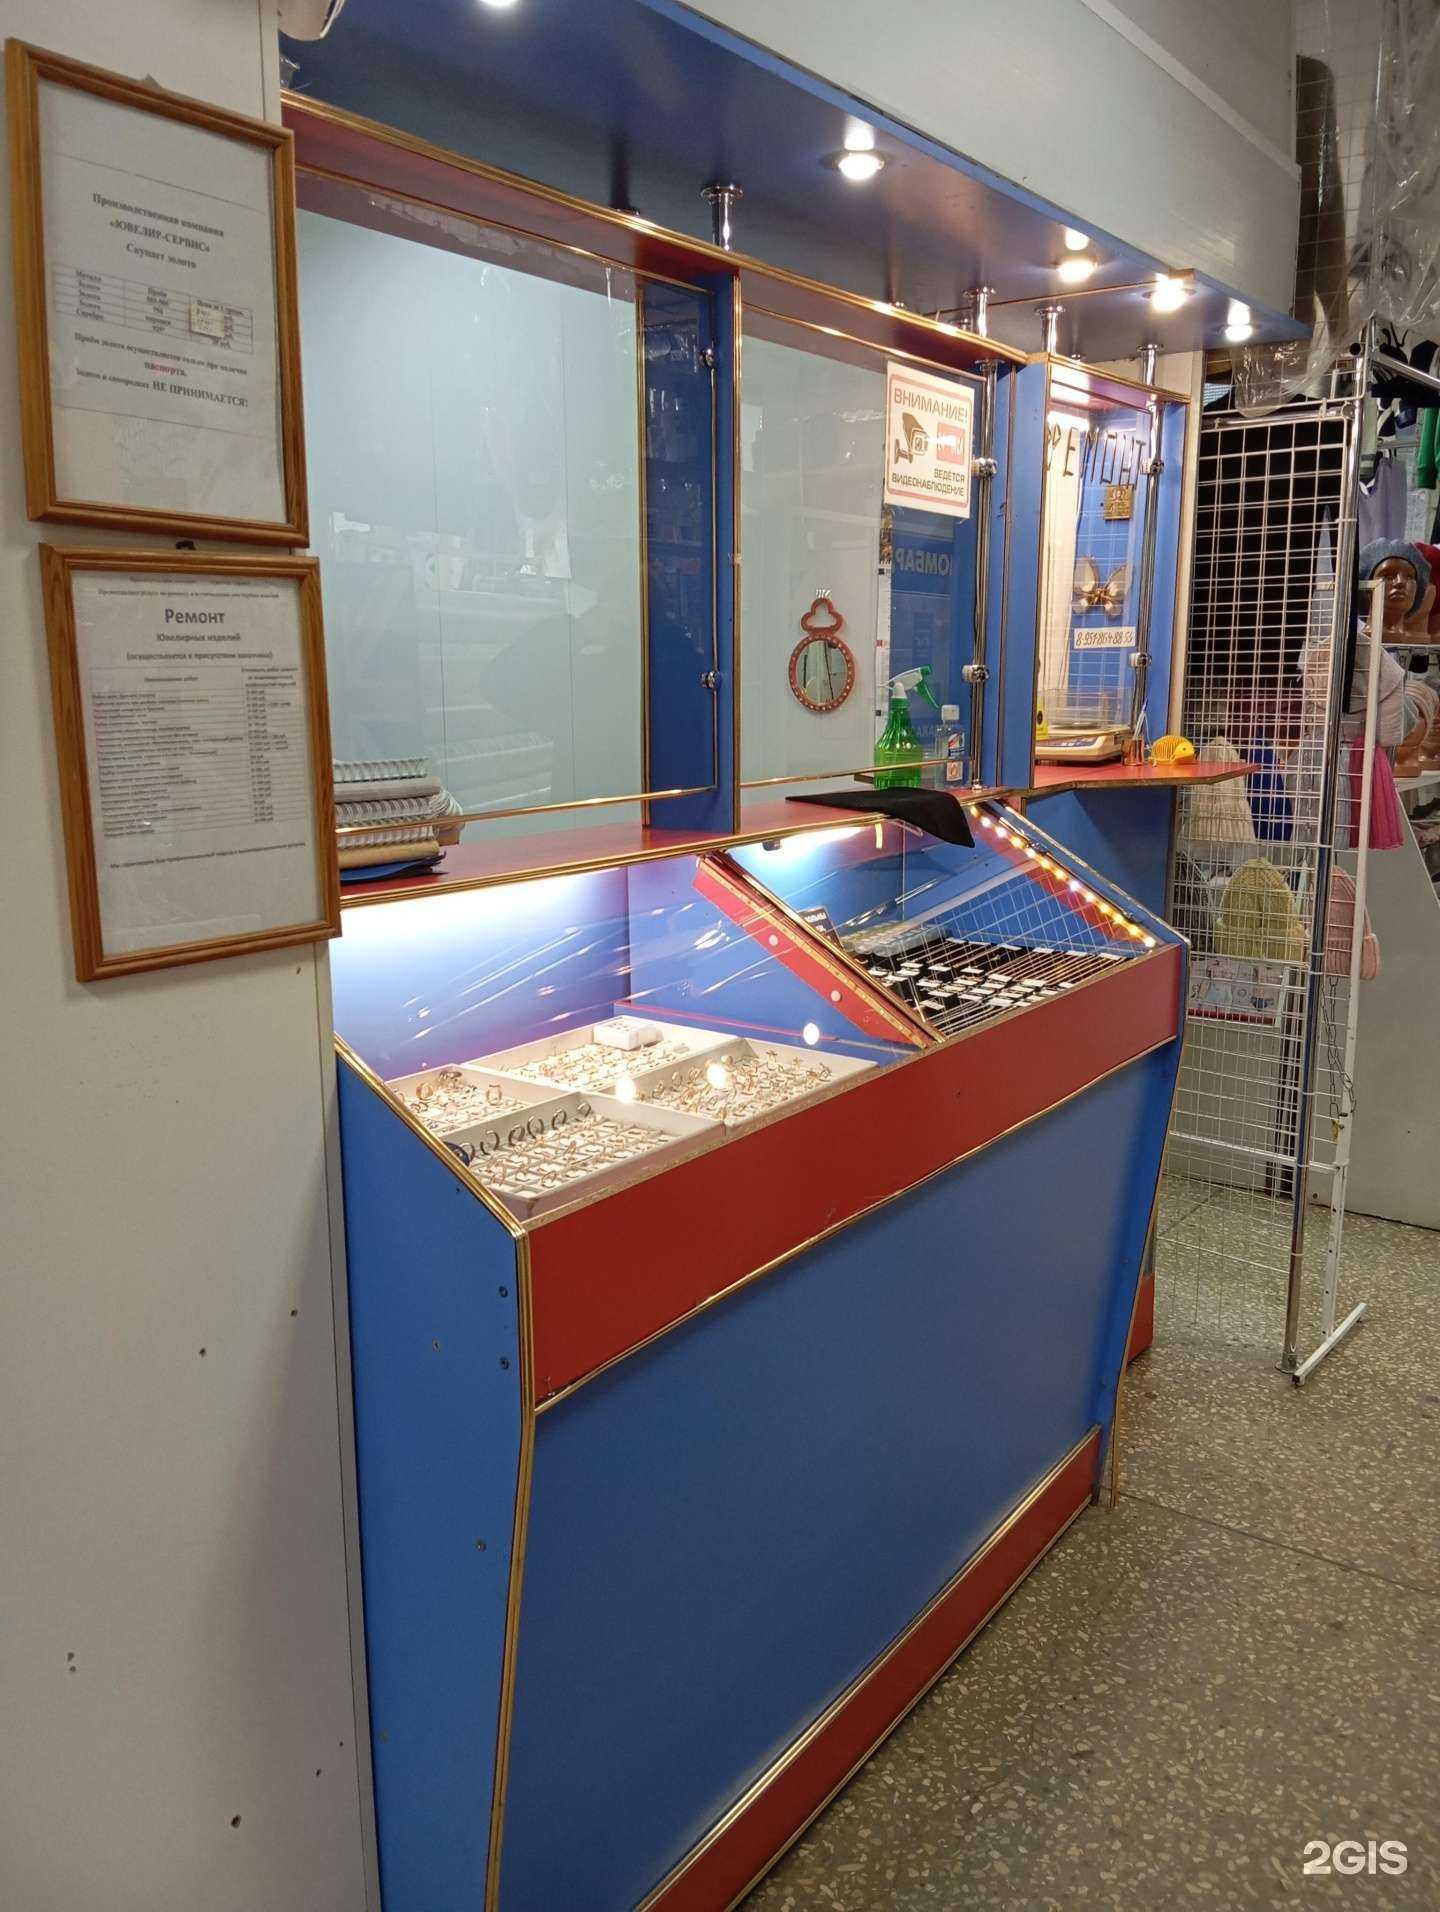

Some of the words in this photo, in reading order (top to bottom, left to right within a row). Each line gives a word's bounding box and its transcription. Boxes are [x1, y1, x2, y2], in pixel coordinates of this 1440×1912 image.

[93, 192, 179, 225] Производственная
[181, 219, 225, 237] компания
[152, 380, 168, 393] НЕ
[169, 384, 249, 409] ПРИНИМАЕТСЯ!
[894, 387, 968, 424] ВНИМАНИЕ!
[891, 472, 965, 498] ВИДЕОНАБЛЮДЕНИЕ
[934, 468, 965, 484] ВЕДЁТСЯ
[164, 608, 226, 625] Ремонт
[156, 632, 206, 643] Ювелирных
[207, 632, 241, 643] изделий
